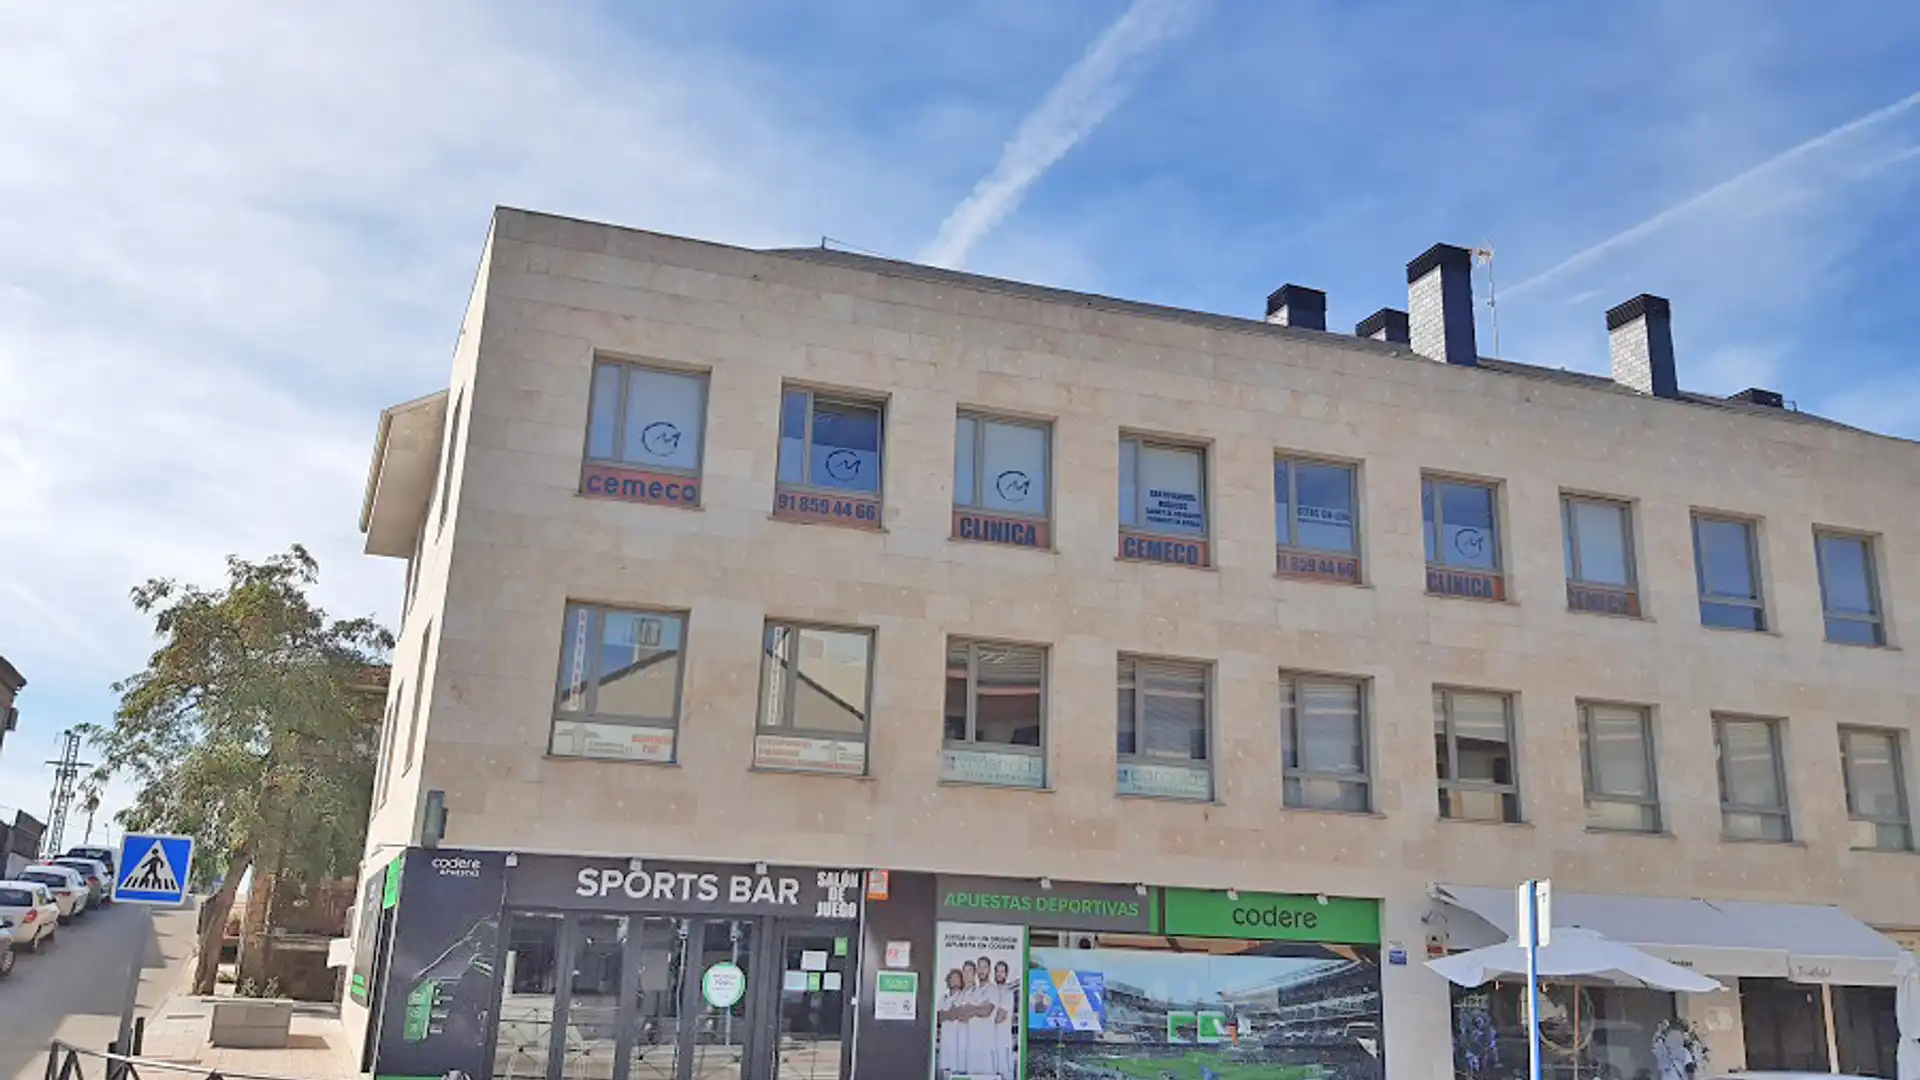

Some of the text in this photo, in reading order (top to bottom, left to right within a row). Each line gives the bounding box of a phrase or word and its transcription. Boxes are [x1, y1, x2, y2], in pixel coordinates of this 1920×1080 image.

[586, 475, 697, 502] cemeco
[778, 494, 796, 511] 91
[832, 500, 853, 517] 44
[1124, 536, 1199, 566] CEMECO
[431, 857, 481, 869] codere
[576, 867, 801, 906] SPORTS BAR
[828, 887, 848, 902] DE
[815, 901, 858, 918] JUEGO
[944, 892, 1140, 917] APUESTAS DEPORTIVAS
[1232, 904, 1318, 929] codere
